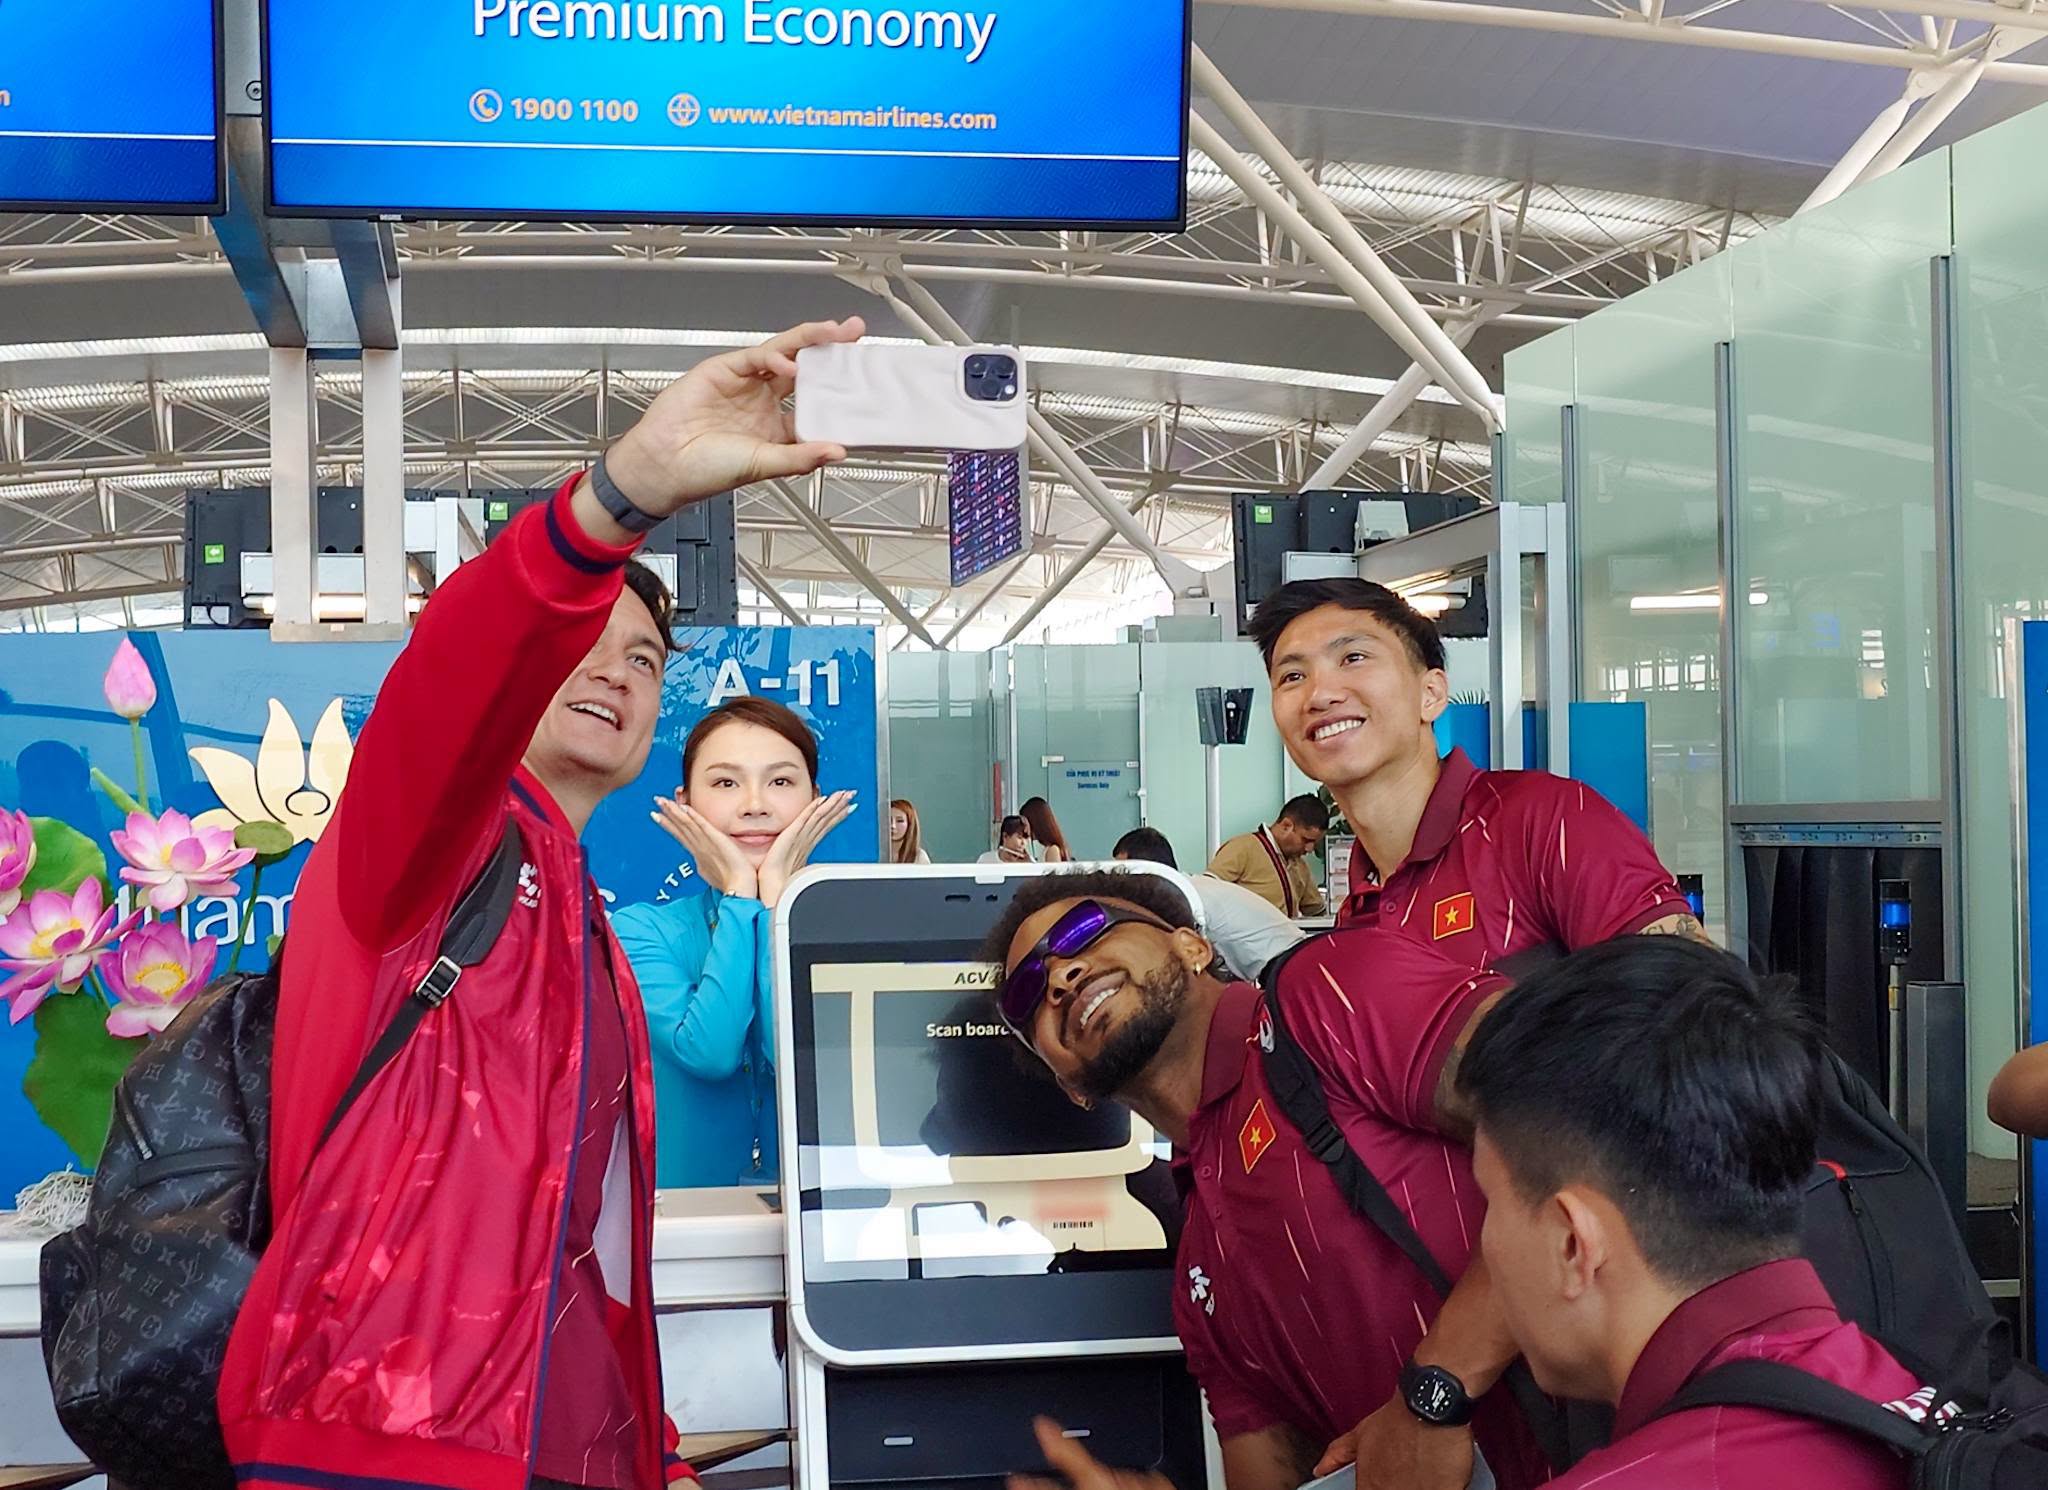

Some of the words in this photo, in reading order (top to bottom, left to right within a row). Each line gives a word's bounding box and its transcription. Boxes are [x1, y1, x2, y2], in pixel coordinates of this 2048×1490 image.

[474, 0, 724, 42] Premium
[744, 0, 997, 63] Economy
[510, 97, 573, 120] 1900
[580, 99, 639, 122] 1100
[708, 104, 997, 130] www.vietnamairlines.com
[707, 658, 840, 706] A-11
[656, 862, 694, 901] YTE
[926, 1023, 963, 1037] Scan
[966, 1021, 1010, 1037] boar
